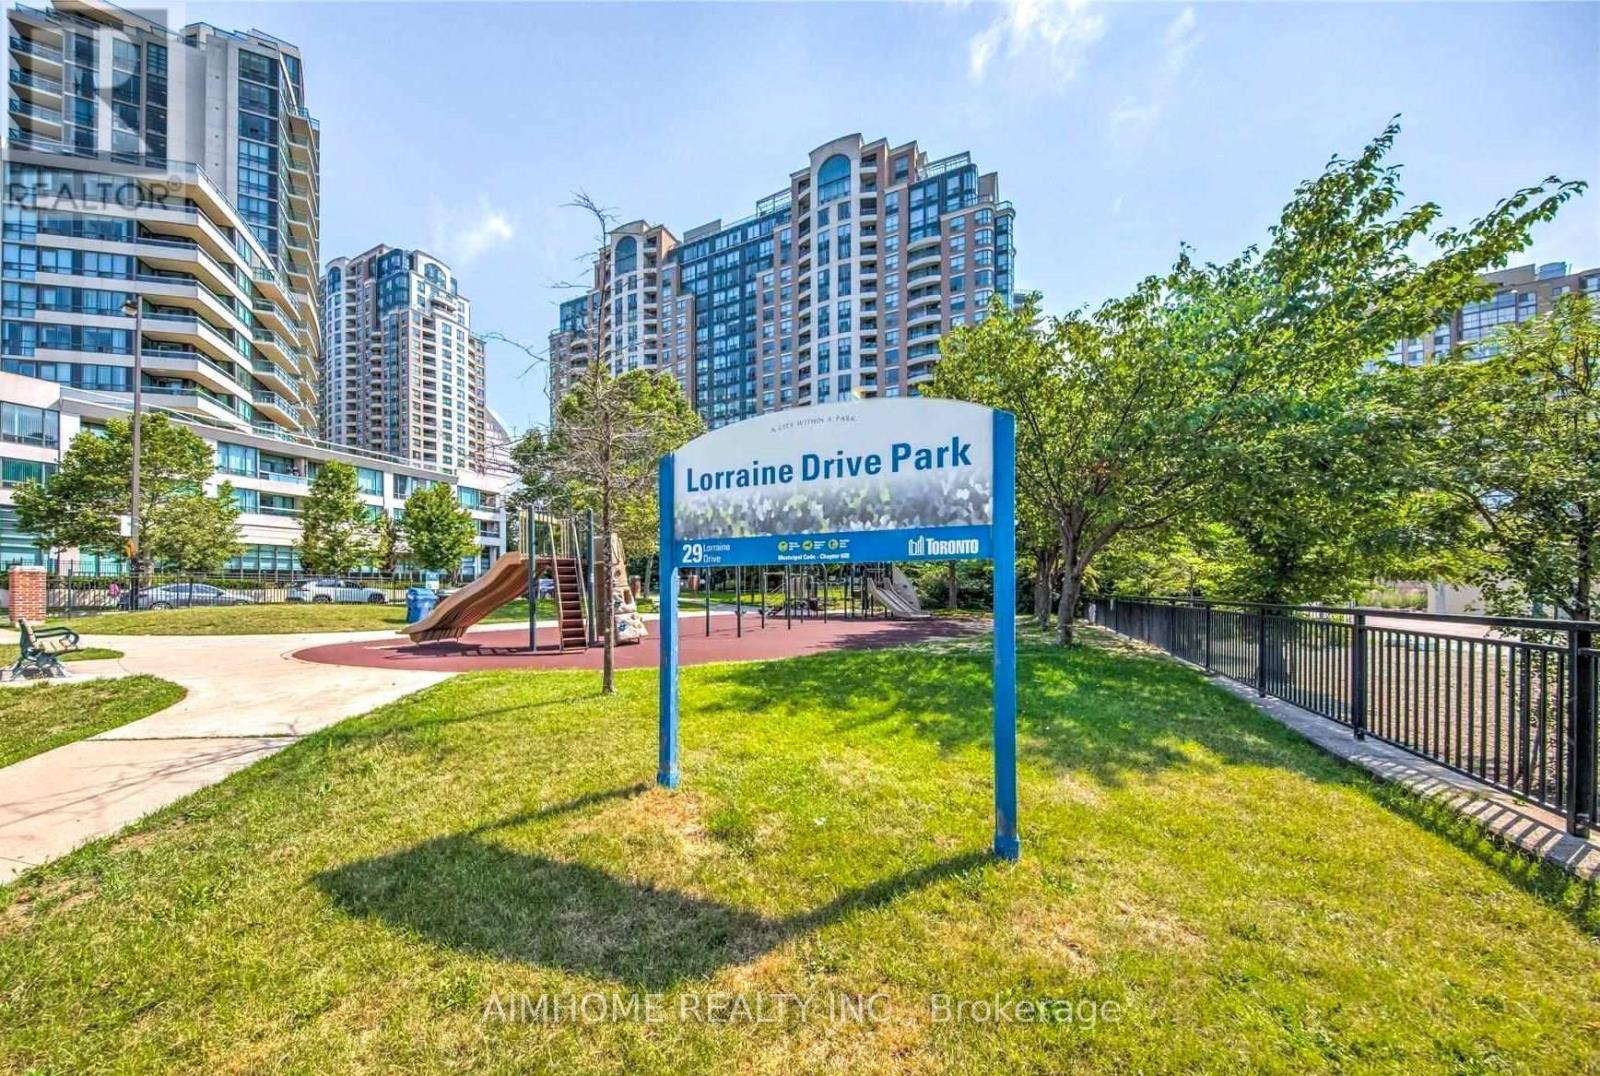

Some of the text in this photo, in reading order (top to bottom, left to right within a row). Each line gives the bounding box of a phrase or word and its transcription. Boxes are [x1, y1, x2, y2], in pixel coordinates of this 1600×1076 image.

[687, 436, 972, 493] Lorraine Drive Park
[682, 543, 703, 564] 29
[703, 544, 731, 552] Lorraine
[925, 538, 979, 555] TORONTO
[703, 555, 721, 563] Drive
